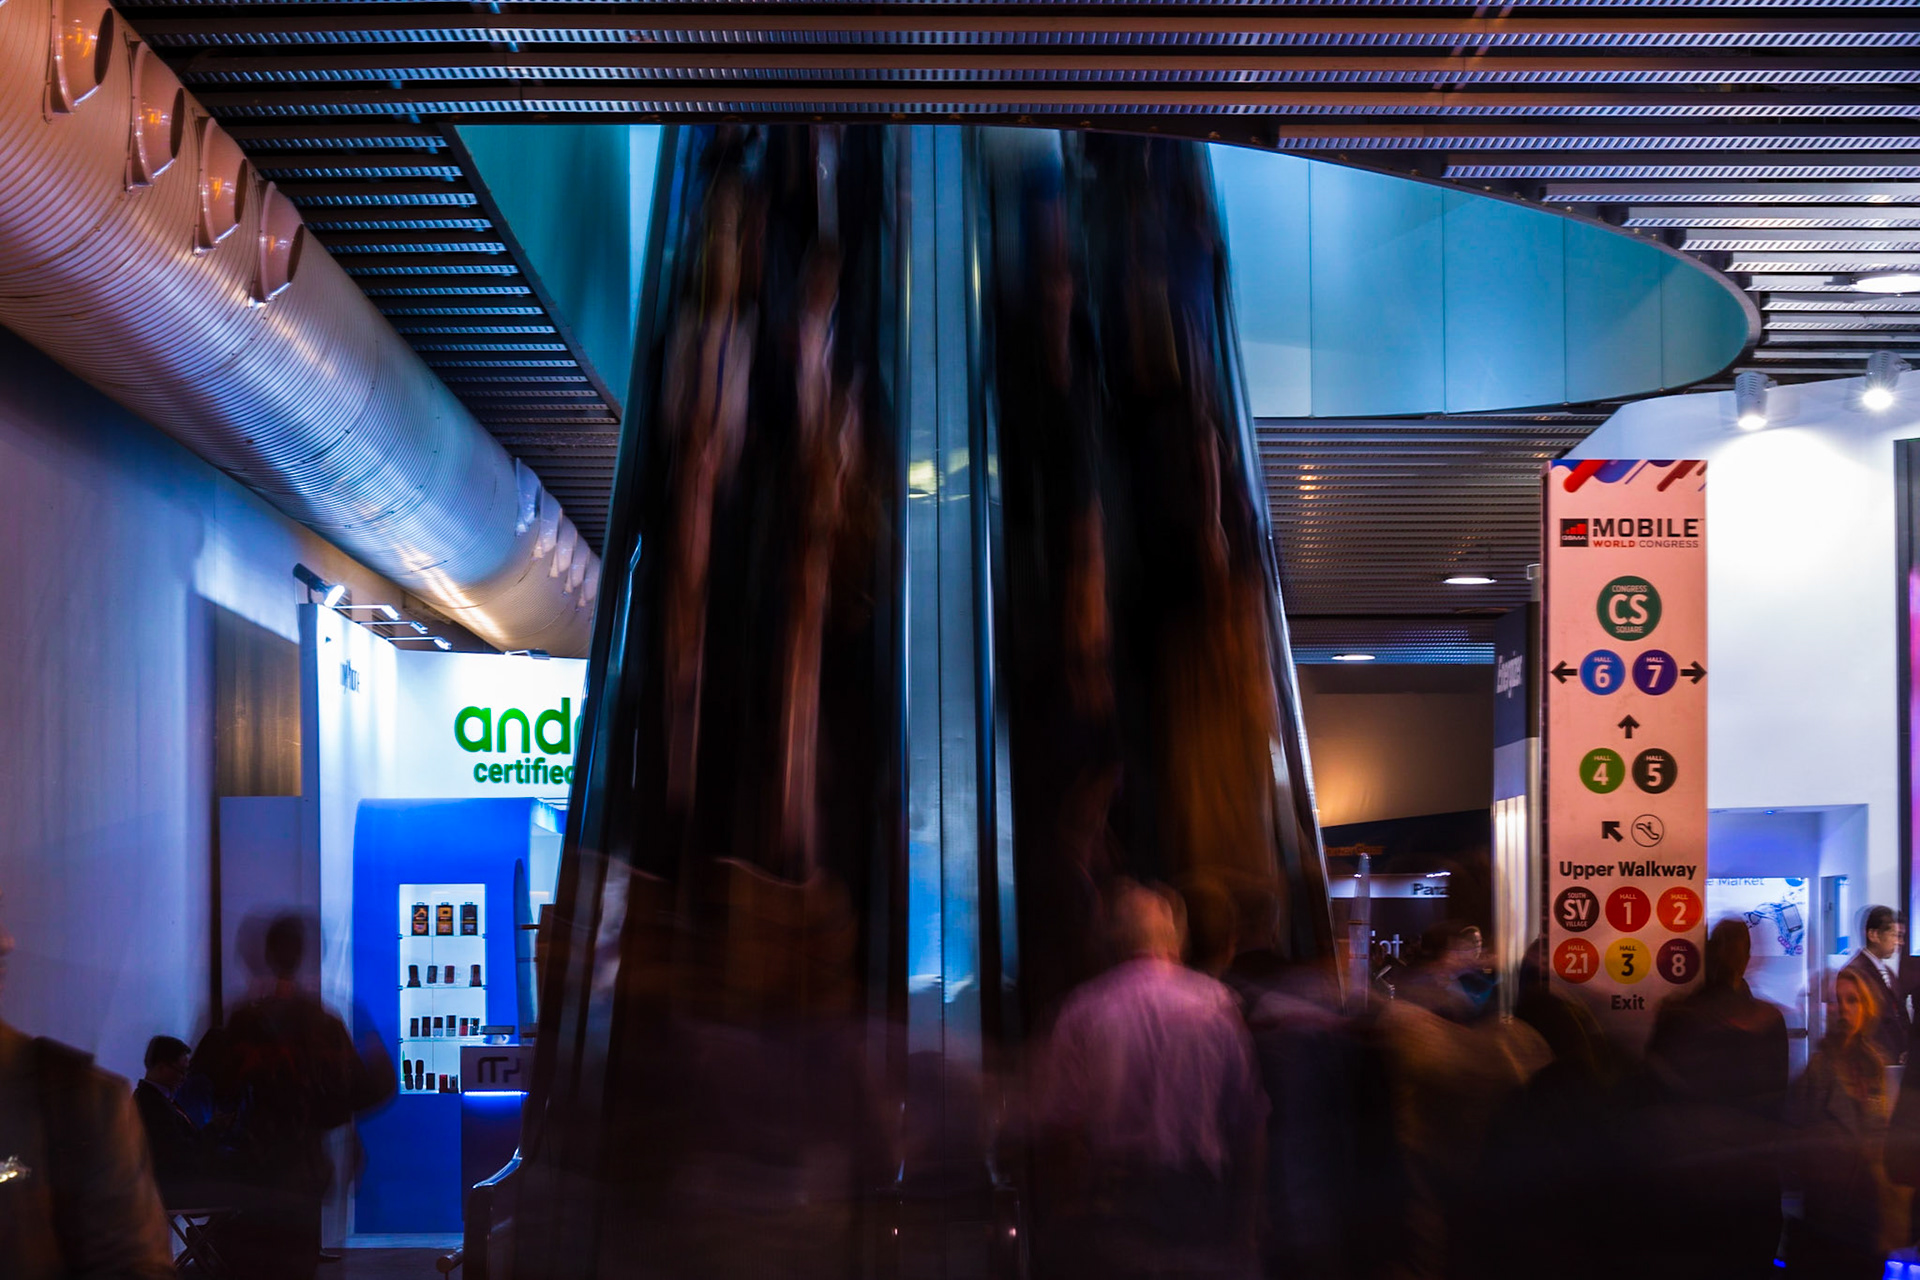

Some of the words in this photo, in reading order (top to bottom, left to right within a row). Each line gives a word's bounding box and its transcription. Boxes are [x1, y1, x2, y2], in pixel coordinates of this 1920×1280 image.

[1593, 518, 1699, 538] MOBILE
[1593, 540, 1636, 548] WORLD
[1639, 540, 1699, 548] CONGRESS
[1611, 585, 1648, 593] CONGRESS
[1608, 594, 1648, 625] CS
[1615, 626, 1644, 634] SQUARE
[1594, 664, 1611, 688] 6
[1647, 664, 1662, 688] 7
[1592, 762, 1609, 786] 4
[1647, 763, 1662, 787] 5
[1559, 861, 1614, 880] Upper
[1618, 861, 1697, 880] Walkway
[1563, 899, 1590, 921] SV
[1623, 901, 1632, 925] 1
[1672, 901, 1686, 925] 2
[1565, 953, 1588, 974] 2.1
[1621, 953, 1634, 977] 3
[1672, 953, 1686, 977] 8
[1610, 994, 1645, 1010] Exit
